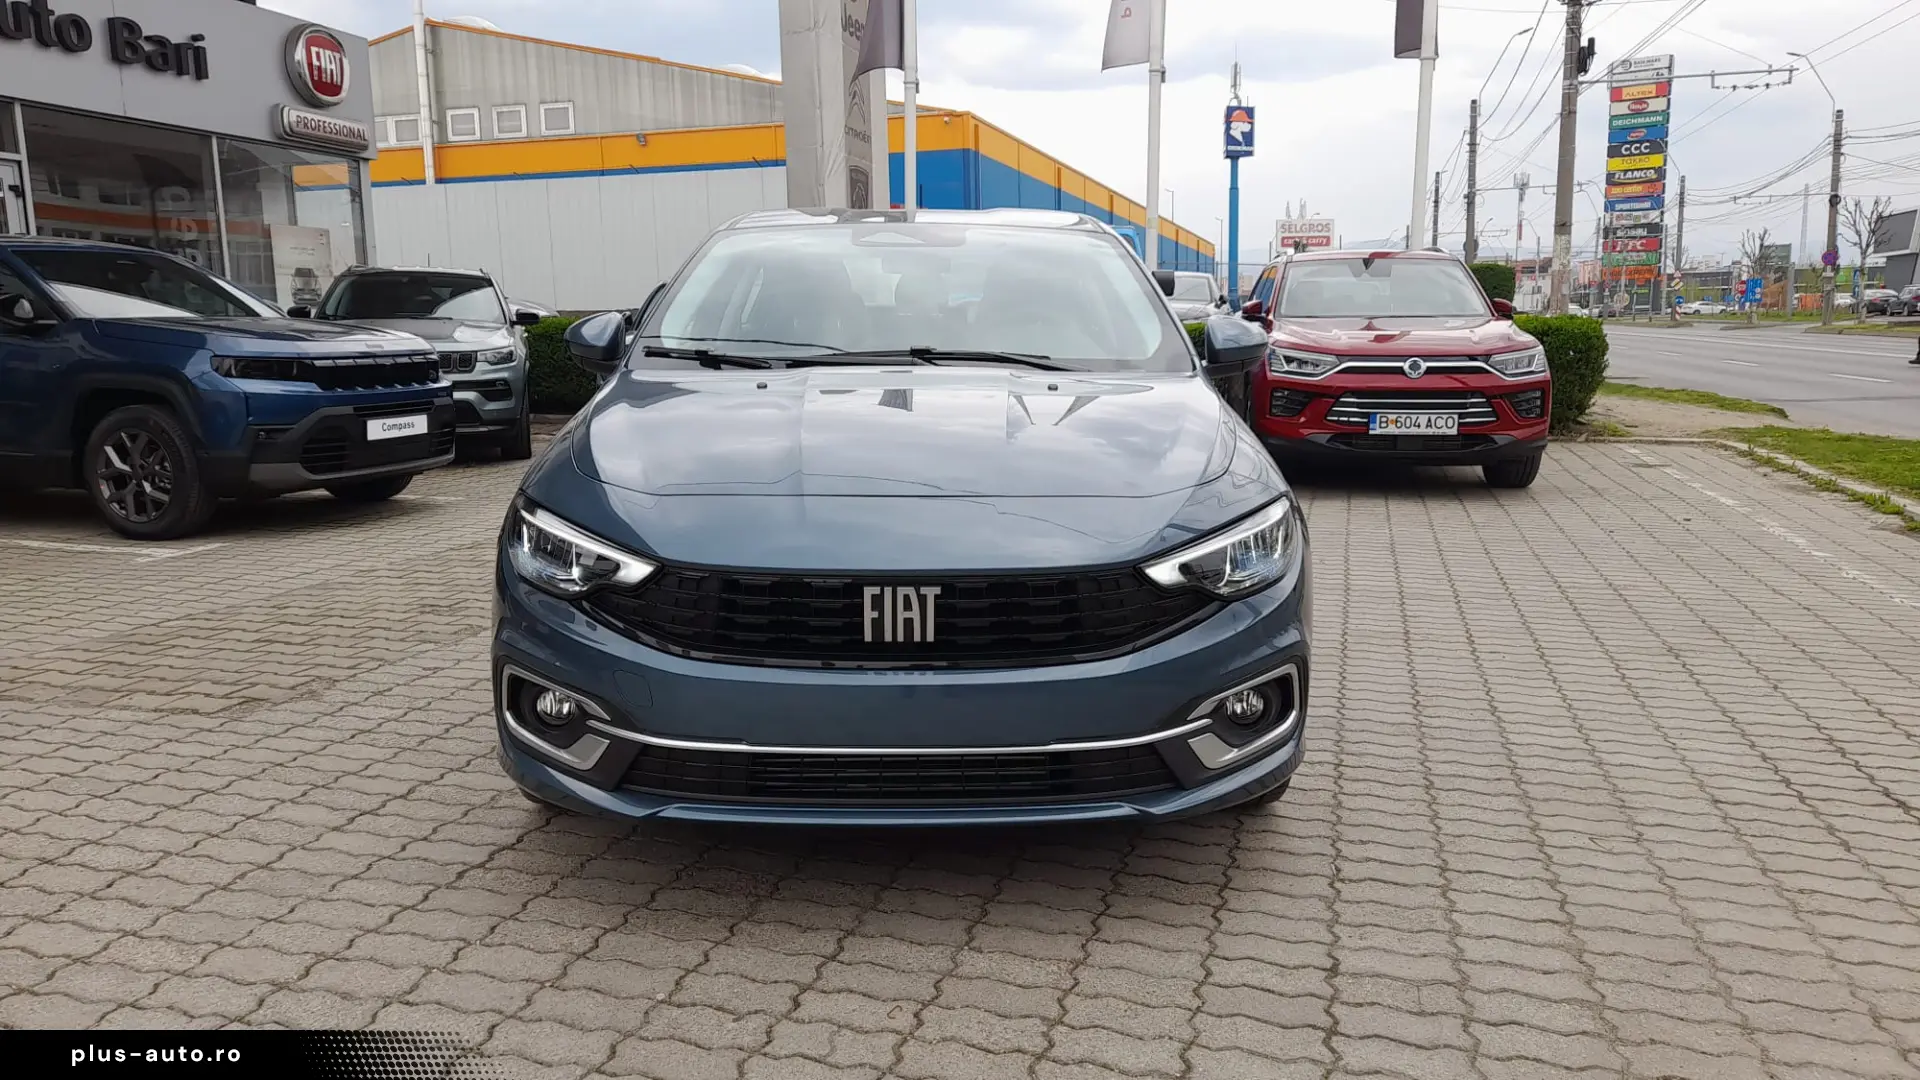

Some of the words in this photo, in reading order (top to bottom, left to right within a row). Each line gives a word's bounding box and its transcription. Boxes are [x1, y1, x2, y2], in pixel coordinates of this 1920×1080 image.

[841, 2, 865, 42] Jee
[0, 0, 92, 52] uto
[107, 16, 209, 81] Bari
[310, 46, 341, 87] FIAT
[296, 114, 368, 142] PROFESSIONAL
[1612, 116, 1663, 126] DEICHMANN
[1621, 143, 1650, 154] CCC
[1614, 169, 1655, 179] FLANCO
[1280, 222, 1332, 234] SELGROS
[381, 420, 415, 432] Compass
[1379, 415, 1389, 429] B
[1395, 415, 1421, 429] 604
[1425, 415, 1456, 429] ACO
[863, 586, 942, 642] FIAT
